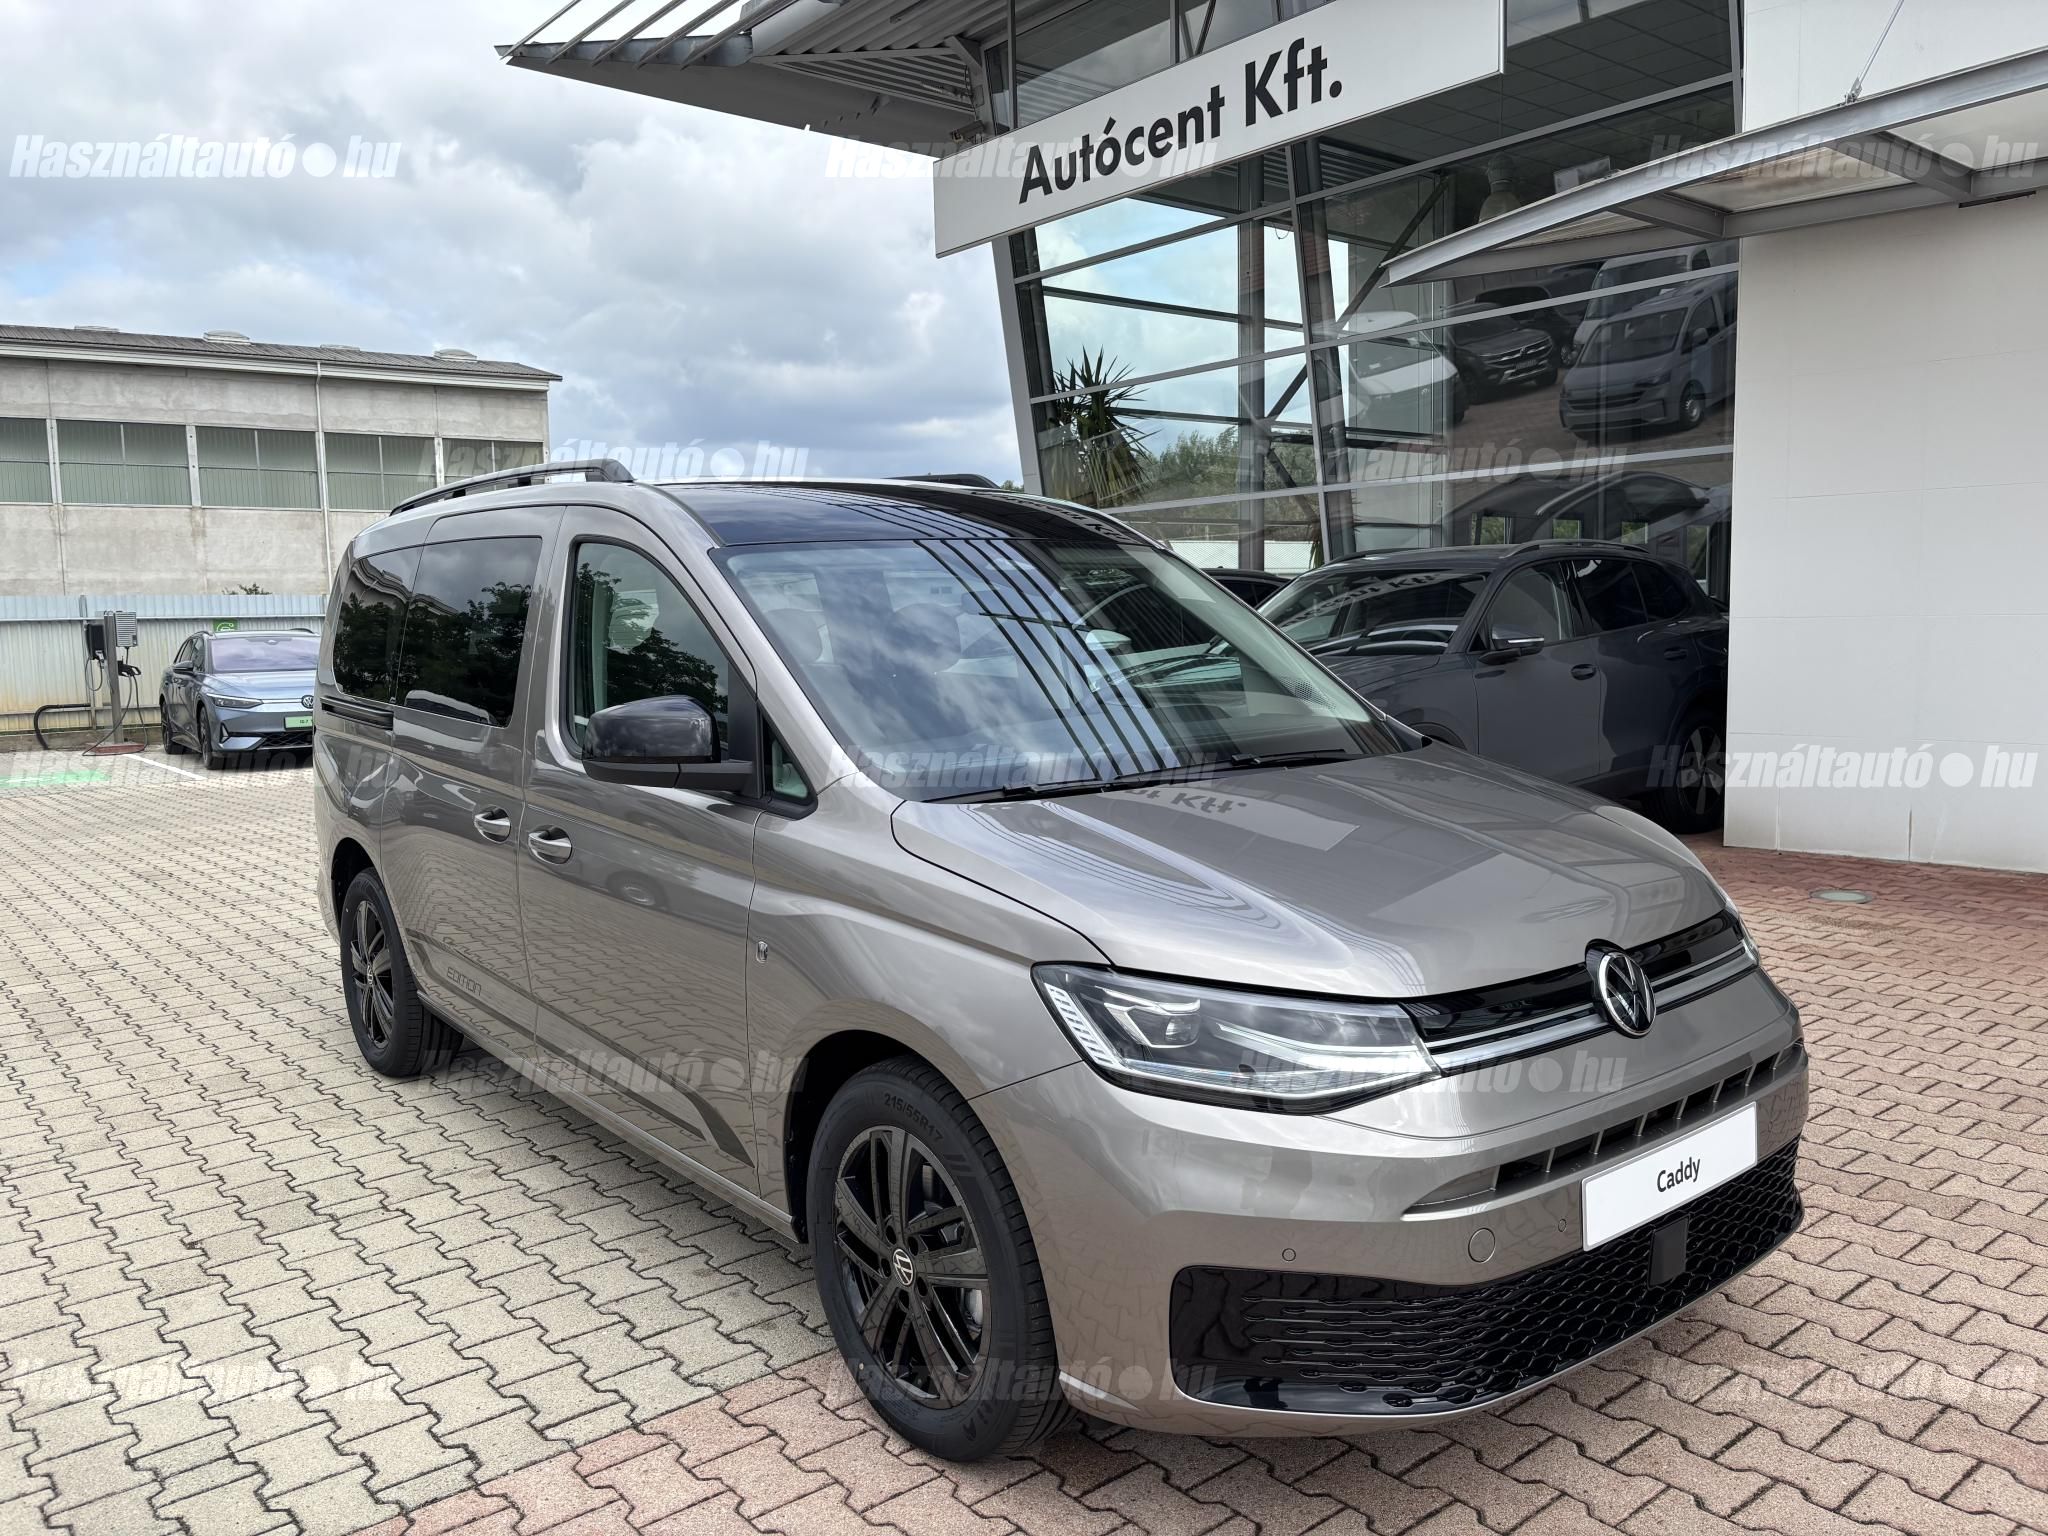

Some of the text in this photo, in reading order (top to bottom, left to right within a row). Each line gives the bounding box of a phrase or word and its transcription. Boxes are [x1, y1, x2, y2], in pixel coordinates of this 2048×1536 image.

[1019, 37, 1343, 204] Autócent Kft.
[884, 1092, 944, 1142] 215/55R17
[1657, 1156, 1701, 1193] Caddy
